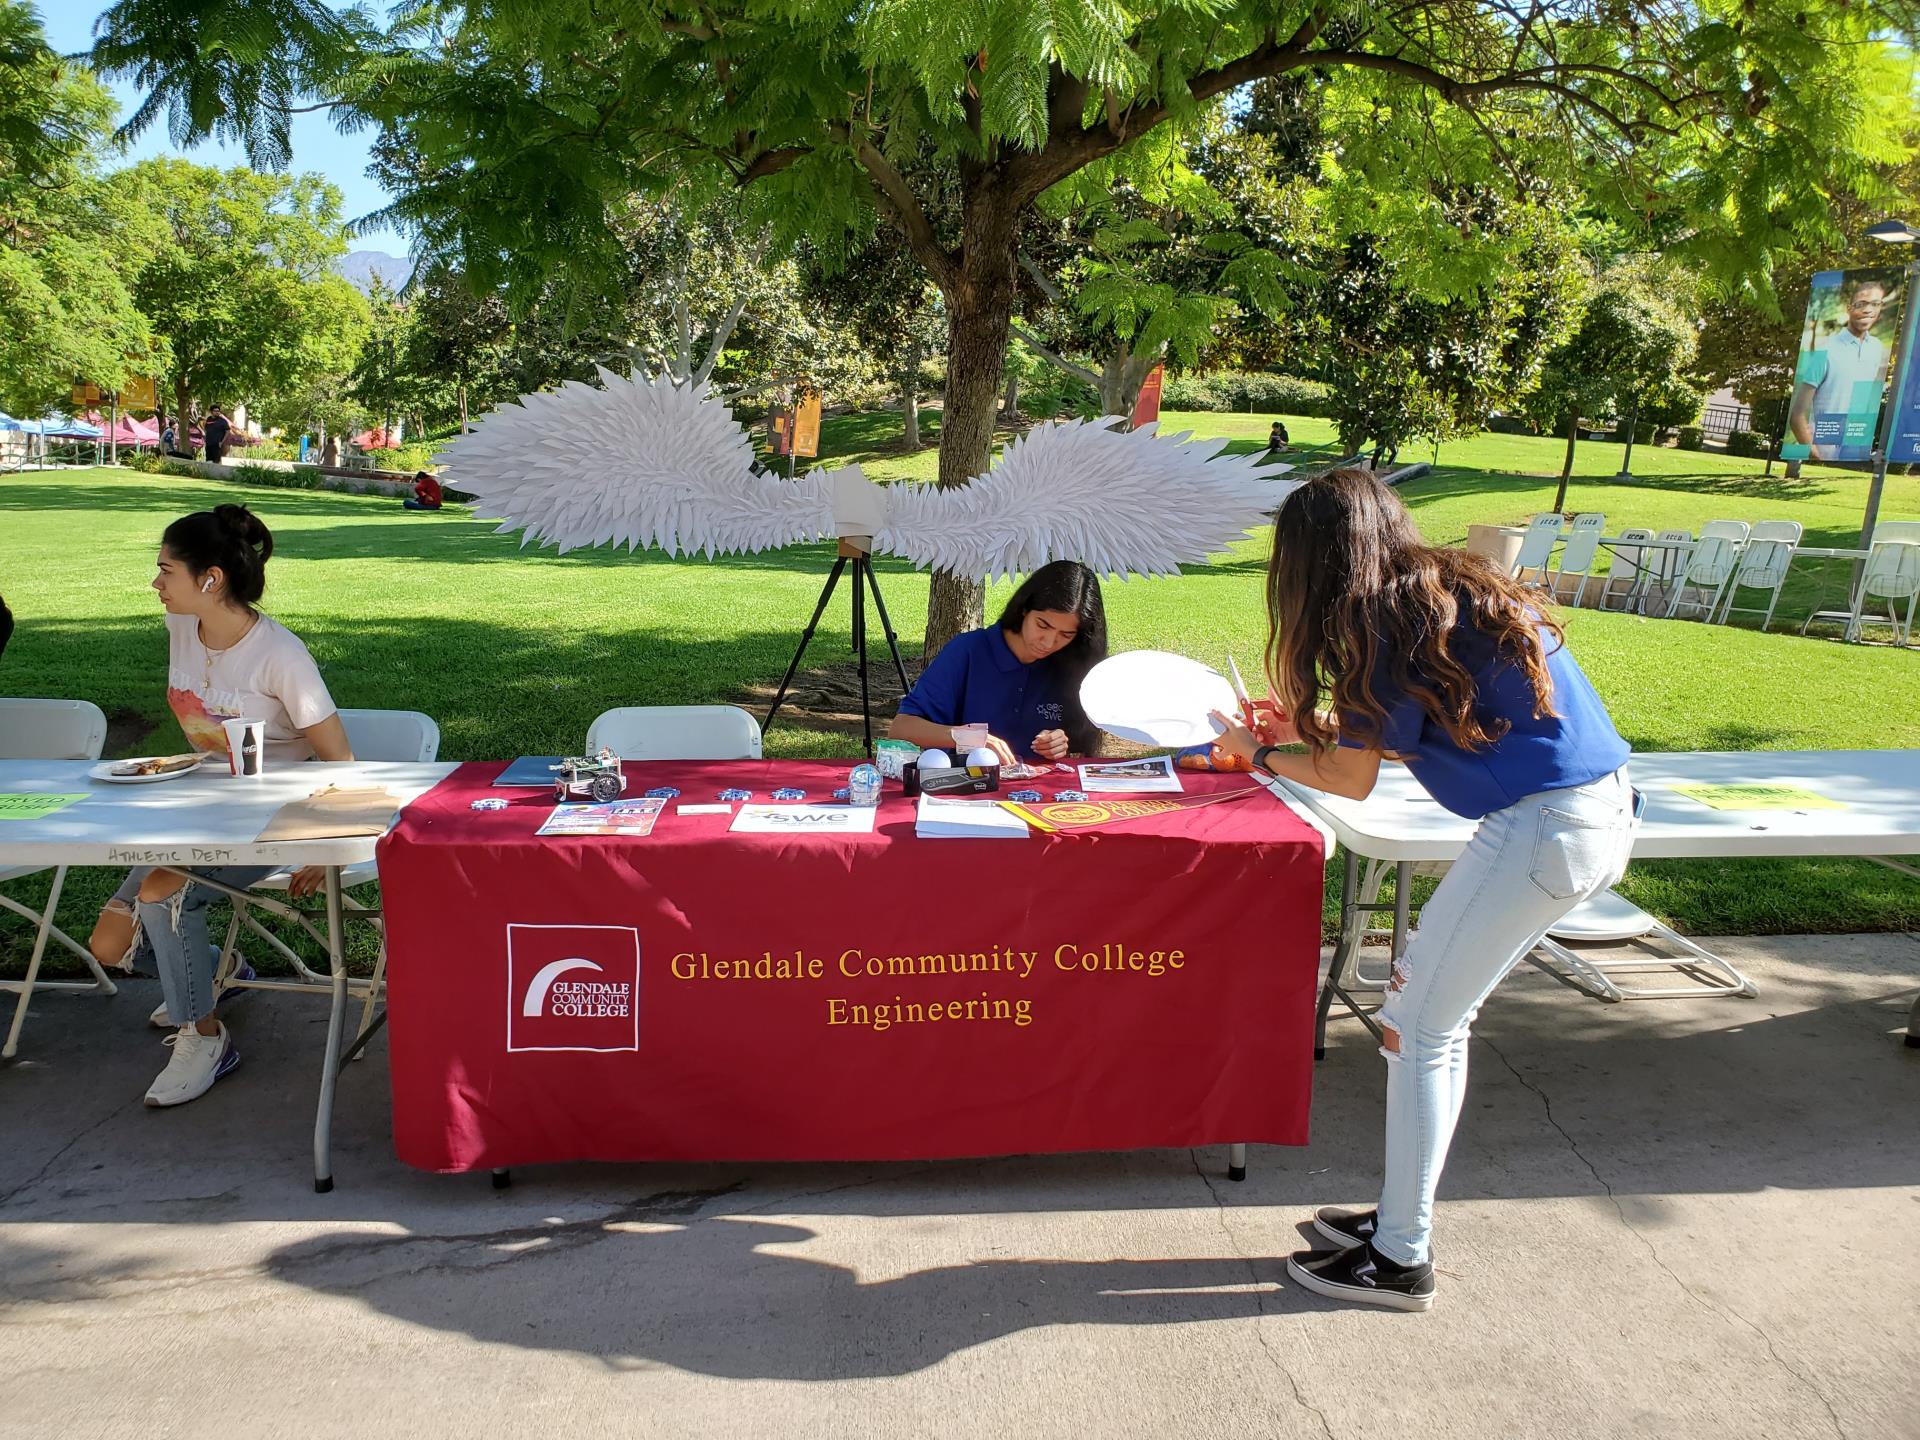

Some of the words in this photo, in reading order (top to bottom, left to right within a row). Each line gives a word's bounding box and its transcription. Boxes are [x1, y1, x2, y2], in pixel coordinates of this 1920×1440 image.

[108, 848, 182, 862] ATHLETIC
[670, 950, 824, 980] Glendale
[838, 944, 1038, 978] Community
[1053, 943, 1186, 977] College
[552, 982, 630, 995] GLENDALE
[551, 993, 629, 1005] COMMUNITY
[551, 1003, 629, 1017] COLLEGE
[826, 991, 1033, 1031] Engineering
